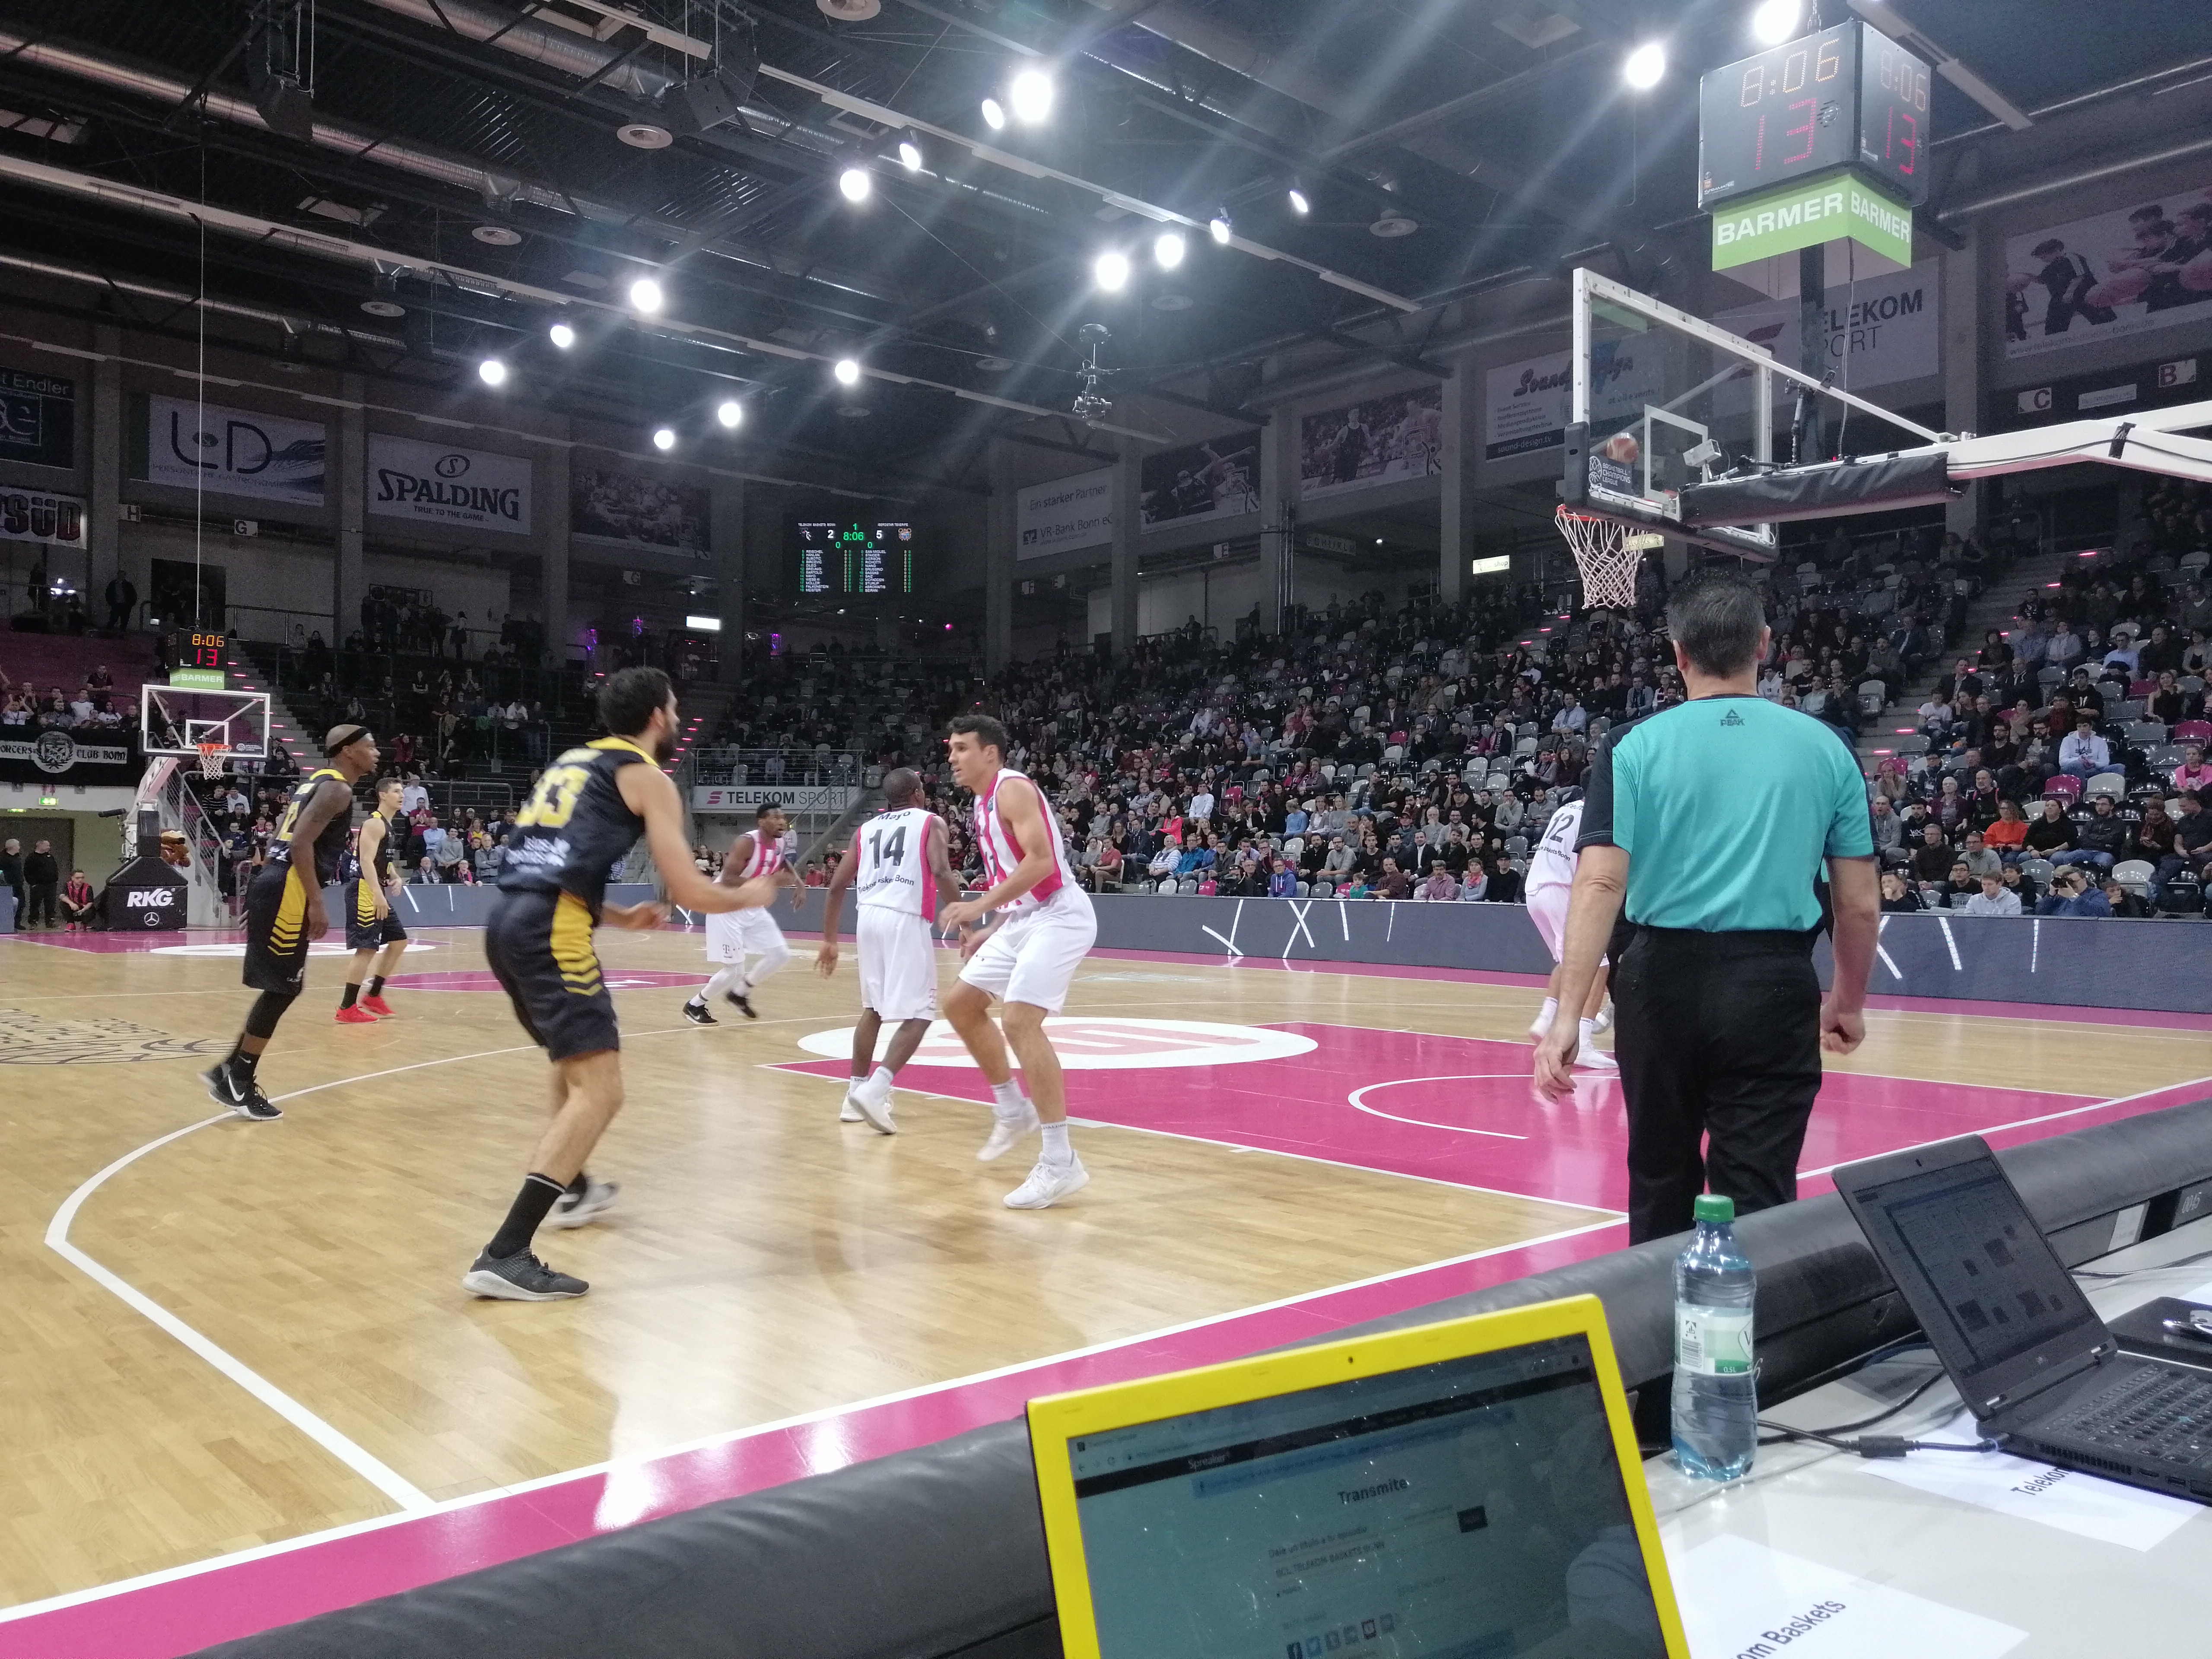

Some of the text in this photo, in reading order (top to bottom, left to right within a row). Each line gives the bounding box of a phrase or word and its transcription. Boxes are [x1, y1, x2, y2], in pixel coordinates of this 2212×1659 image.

[1741, 38, 1839, 108] 8:06
[1880, 50, 1926, 111] 8:06
[1755, 98, 1817, 170] 13
[1886, 106, 1916, 174] 13
[1717, 192, 1843, 245] BARMER
[1851, 191, 1910, 243] BARMER
[13, 373, 70, 395] Endler
[2160, 365, 2177, 385] B
[2034, 389, 2050, 409] C
[1497, 435, 1552, 453] sound-design.tv
[1602, 462, 1627, 476] BASKETBALL
[1602, 469, 1631, 483] CHAMPIONS
[1602, 476, 1618, 486] LEAGUE
[377, 468, 519, 521] SPALDING
[1044, 493, 1074, 508] starker
[1076, 485, 1107, 499] Partner
[128, 505, 140, 522] H
[413, 505, 433, 514] TRUE
[462, 512, 485, 522] GAME
[235, 521, 248, 534] G
[827, 529, 834, 539] 2
[843, 531, 864, 541] 8:06
[876, 530, 882, 539] 5
[1040, 523, 1075, 538] VR-Bank
[1077, 518, 1100, 531] Bonn
[192, 634, 224, 647] 8:06
[197, 648, 218, 666] 13
[181, 674, 223, 683] BARMER
[1720, 718, 1745, 727] PEAK
[727, 791, 845, 804] TELEKOM SPORT
[877, 811, 911, 820] Mayo
[1545, 813, 1574, 843] 12
[869, 826, 906, 869] 14
[1557, 850, 1570, 861] Bonn
[894, 874, 915, 886] Bonn
[127, 888, 173, 907] RKG
[1338, 1477, 1408, 1505] Transmite
[1760, 1600, 1846, 1645] Baskets
